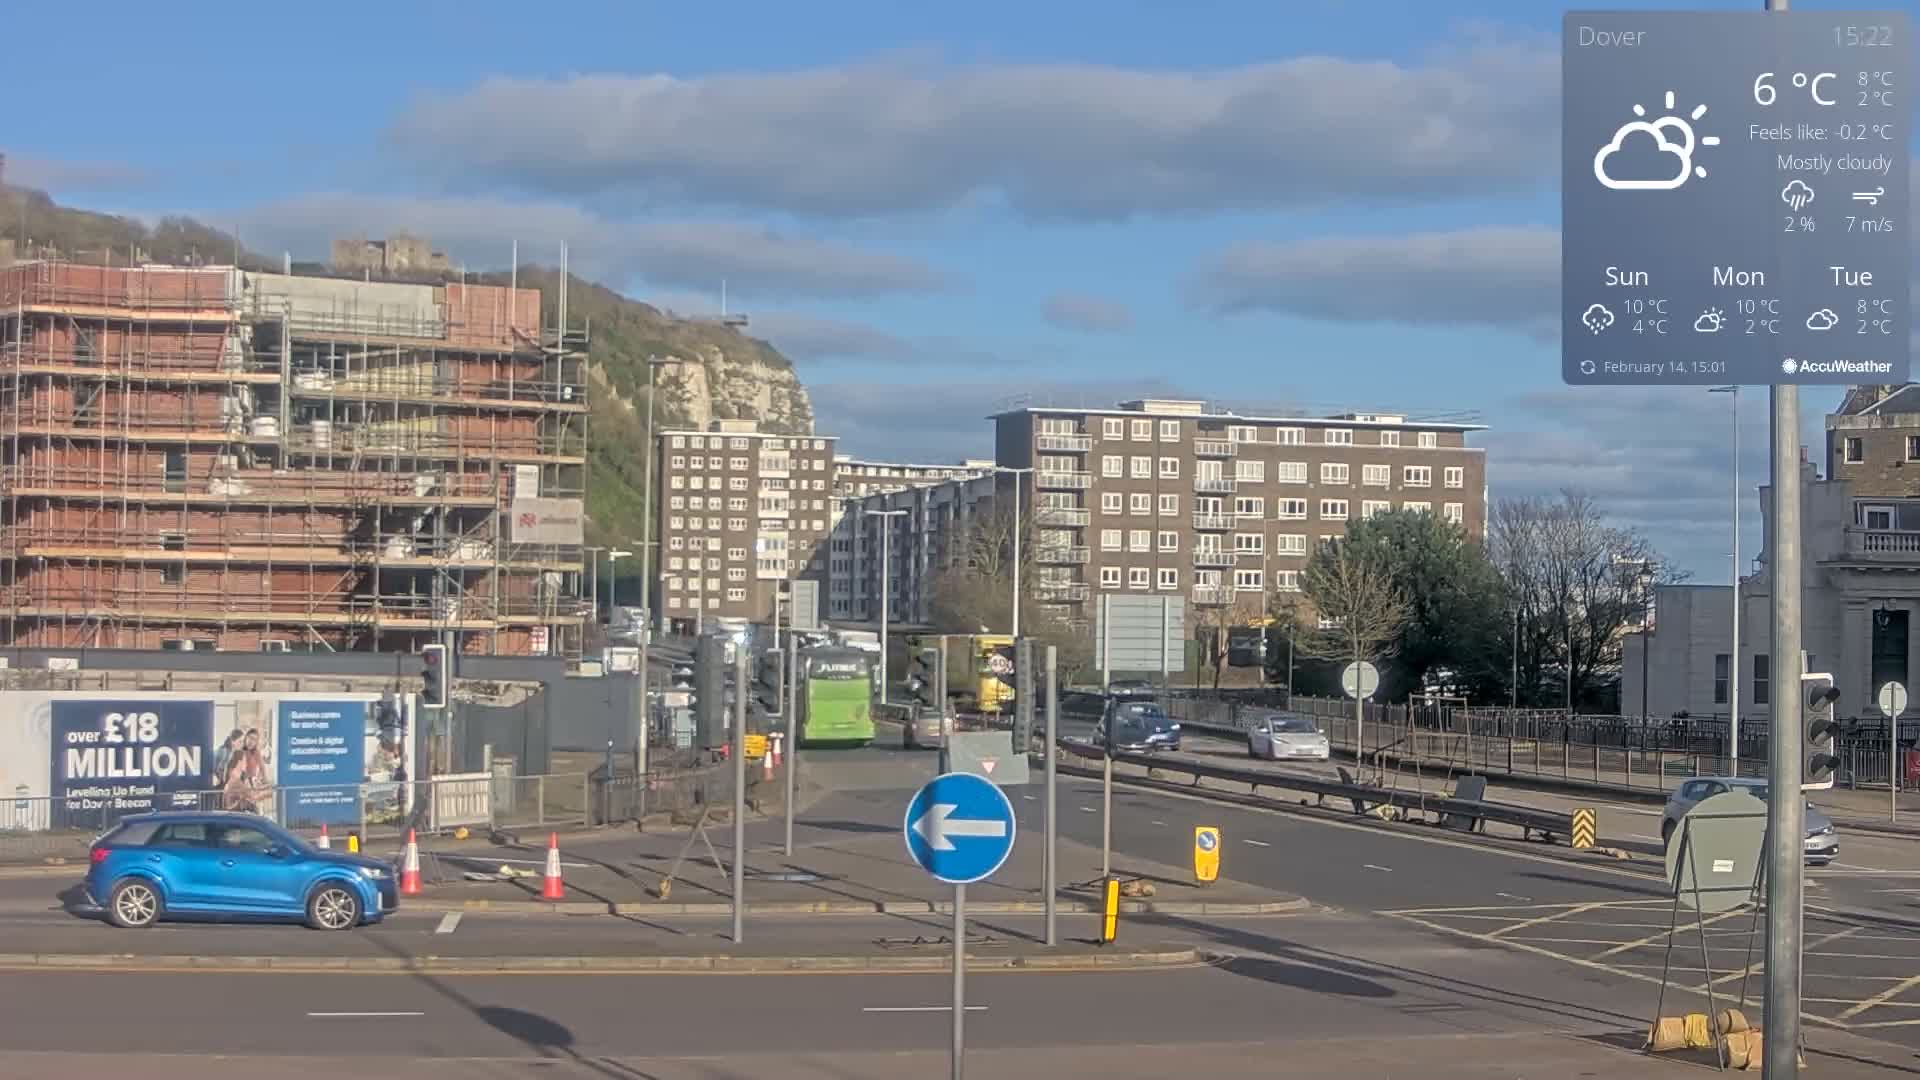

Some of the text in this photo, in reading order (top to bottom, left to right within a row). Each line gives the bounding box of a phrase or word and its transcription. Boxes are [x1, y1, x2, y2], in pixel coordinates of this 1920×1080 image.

[67, 711, 160, 744] over £18
[66, 745, 201, 779] MILLION
[66, 785, 111, 800] Levelling
[129, 785, 155, 797] Fund
[114, 798, 152, 809] Beacon
